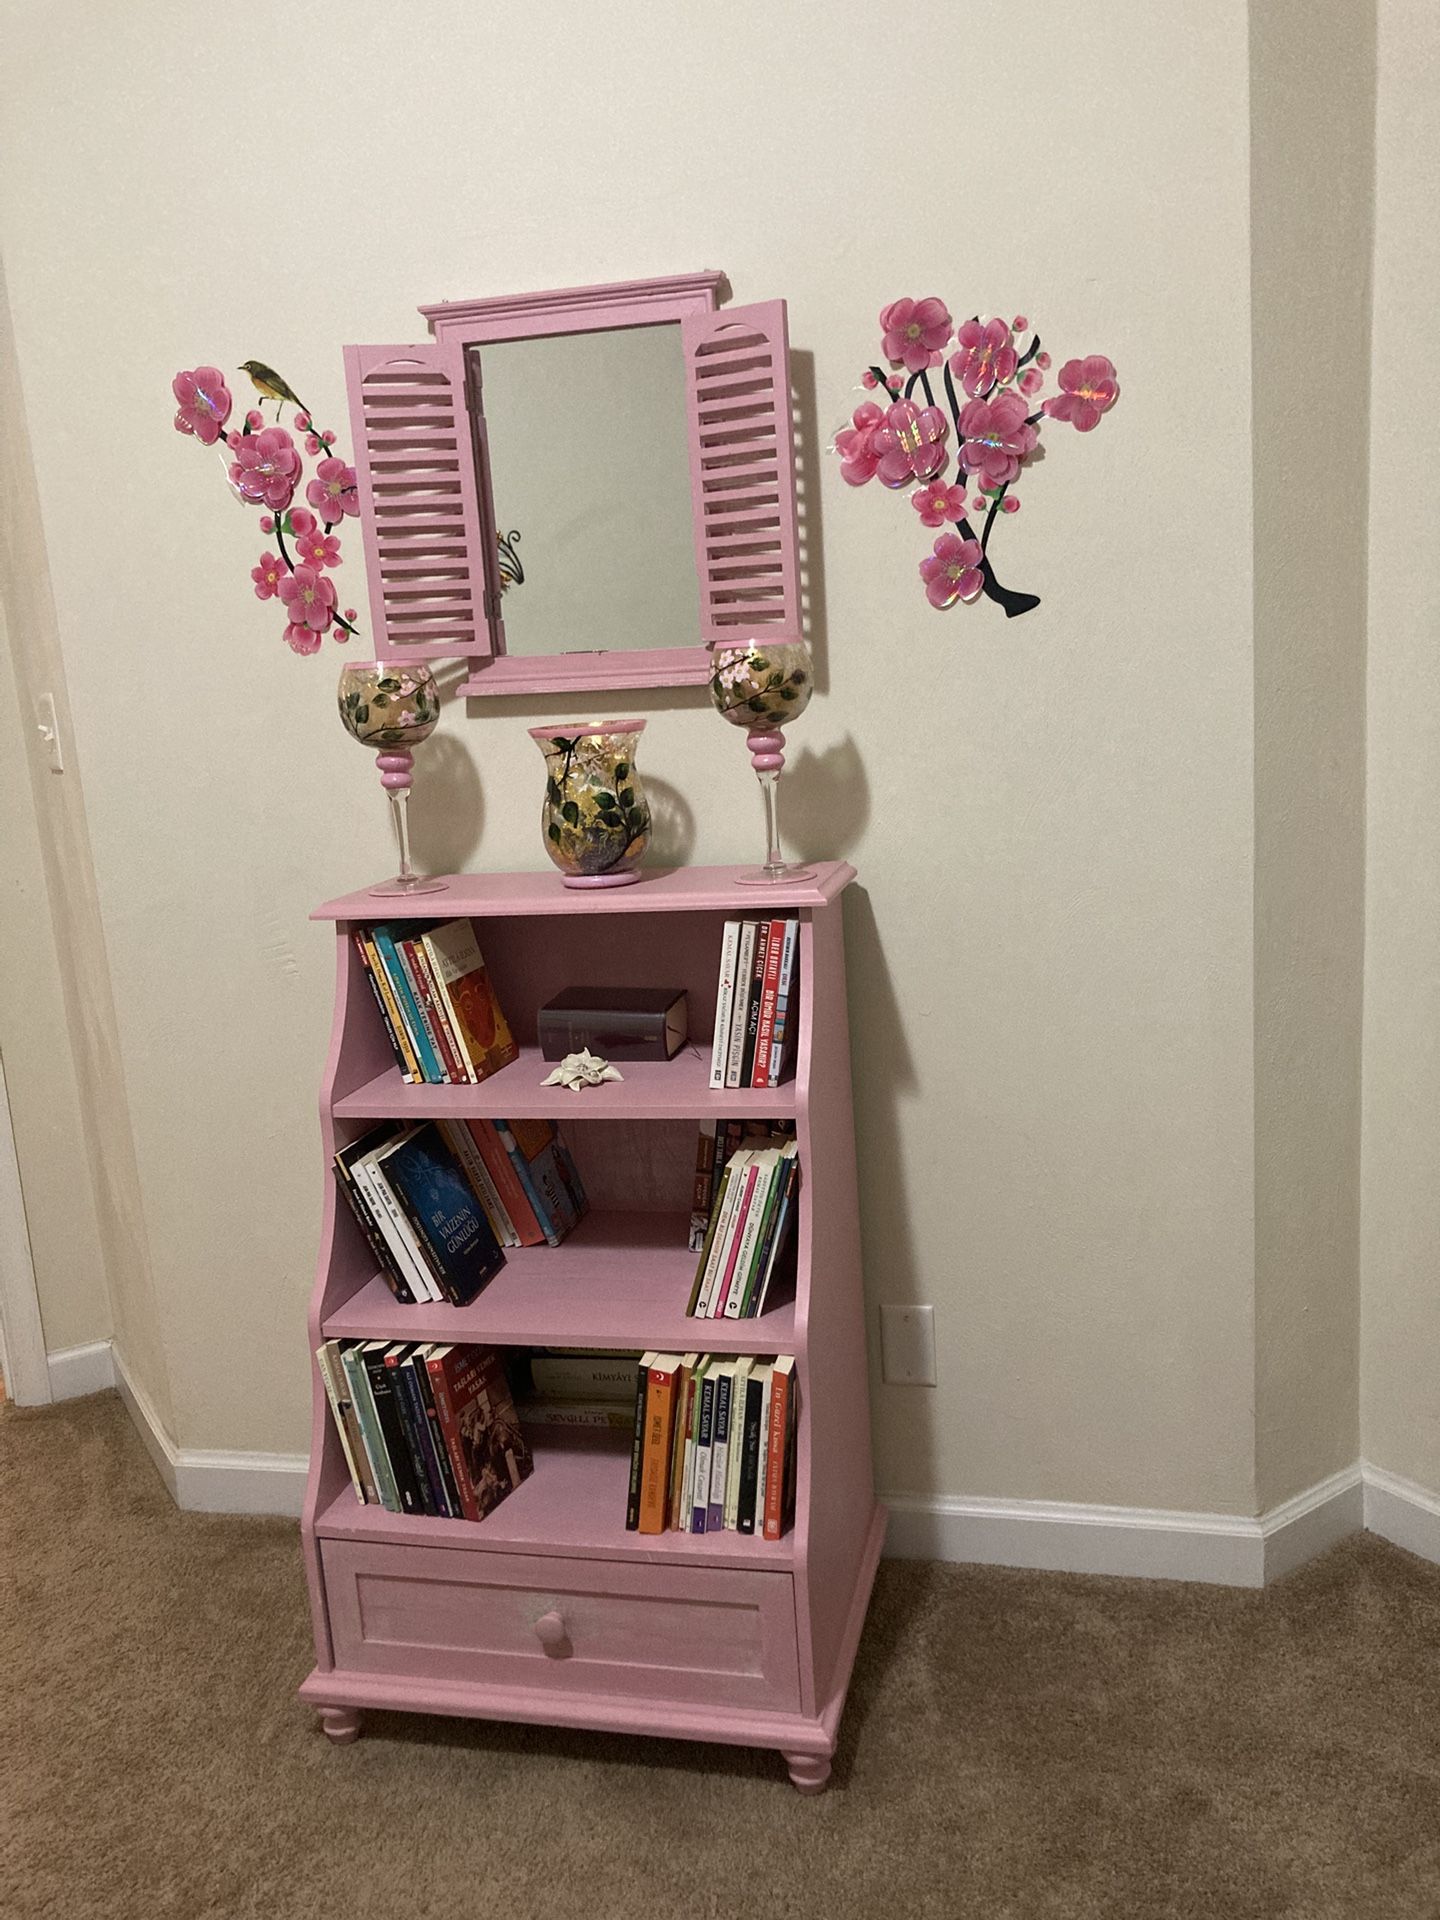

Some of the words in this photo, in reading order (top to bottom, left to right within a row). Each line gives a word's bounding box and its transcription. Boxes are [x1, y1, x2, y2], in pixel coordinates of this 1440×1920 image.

[758, 938, 766, 959] AHMET
[770, 937, 781, 954] İLBER
[755, 960, 763, 978] ÇİÇEK
[768, 955, 779, 980] ORTAYLI
[764, 989, 775, 1000] BİR
[750, 1000, 759, 1020] AÇIM
[762, 1001, 773, 1019] ÖMÜR
[412, 991, 423, 1011] KALK
[420, 1011, 433, 1036] YERİNE
[429, 1037, 438, 1050] YAT
[748, 1021, 757, 1035] AÇ!
[760, 1020, 772, 1037] NASIL
[734, 1023, 743, 1042] YASİN
[432, 1209, 447, 1227] BİR
[439, 1207, 471, 1239] VAİZENİN
[447, 1219, 480, 1254] GÜNLÜĞÜ
[702, 1385, 712, 1412] KEMAL
[719, 1382, 728, 1410] KEMAL
[701, 1413, 710, 1438] SAYAR
[717, 1411, 726, 1435] SAYAR
